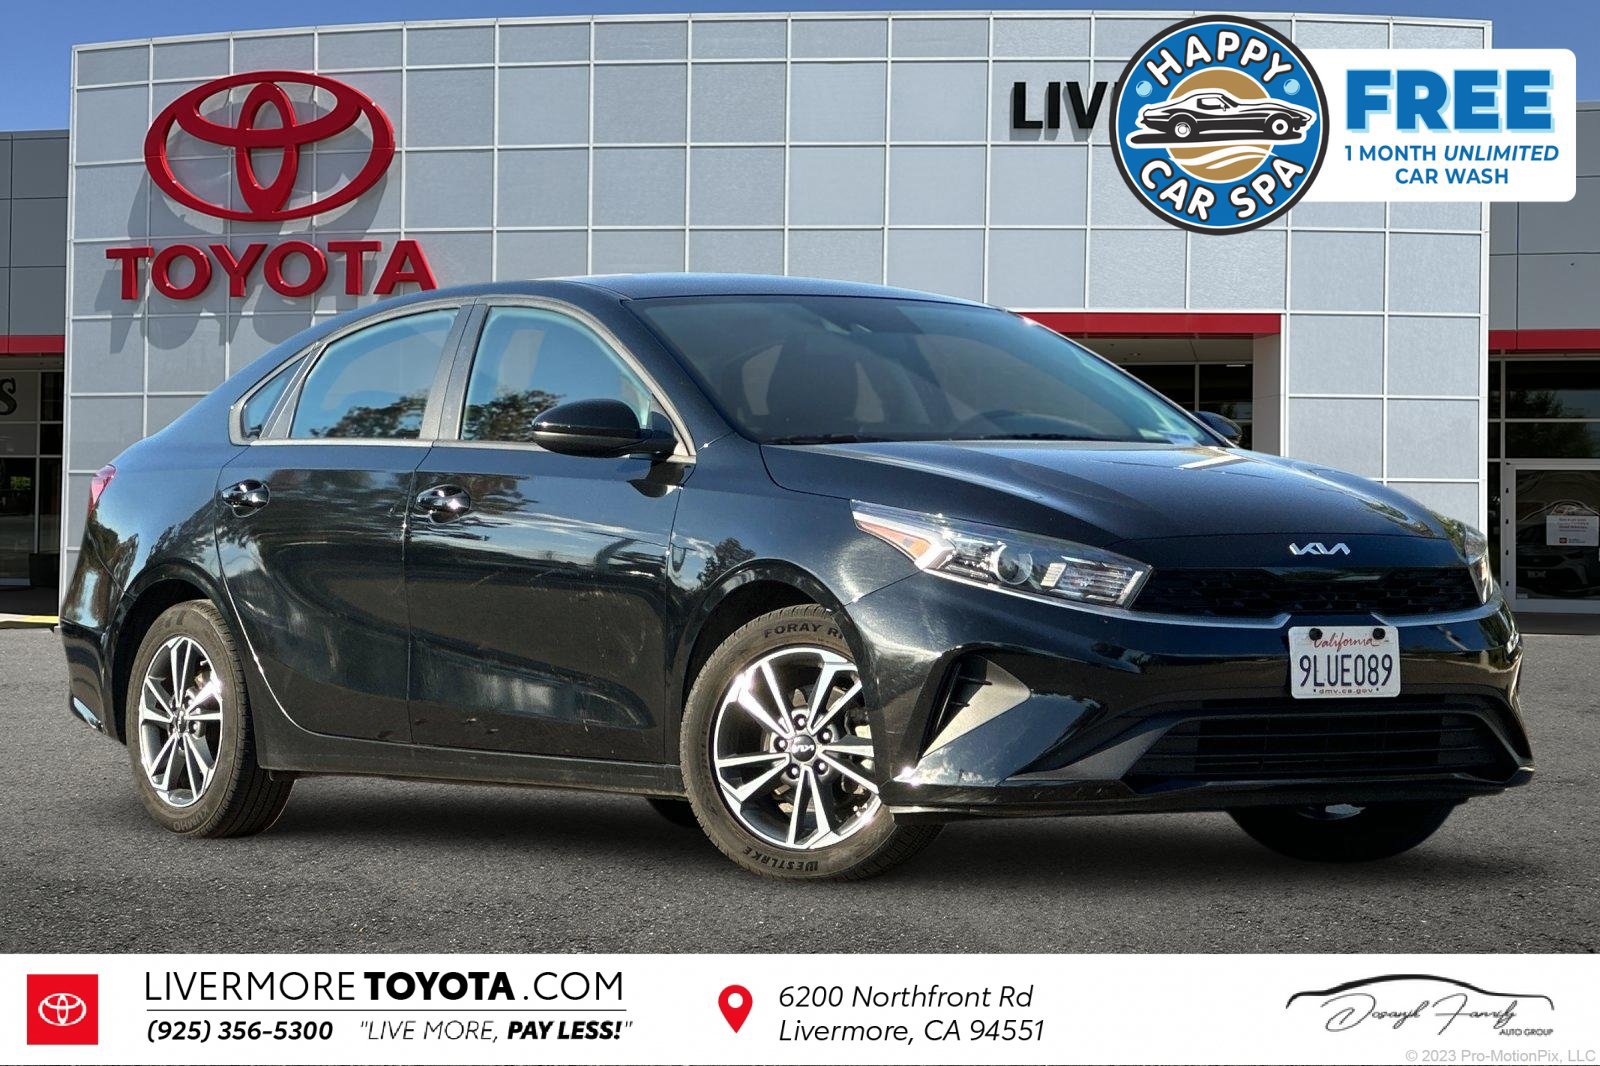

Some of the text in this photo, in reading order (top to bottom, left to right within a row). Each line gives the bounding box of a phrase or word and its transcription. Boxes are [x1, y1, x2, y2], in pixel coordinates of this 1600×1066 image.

[1013, 81, 1119, 129] LIV
[105, 240, 437, 300] TOYOTA
[1289, 542, 1351, 556] KIA
[764, 622, 822, 639] FORAY
[1313, 632, 1373, 652] California
[1299, 653, 1393, 687] 9LUE089
[742, 845, 819, 872] WESTLAKE
